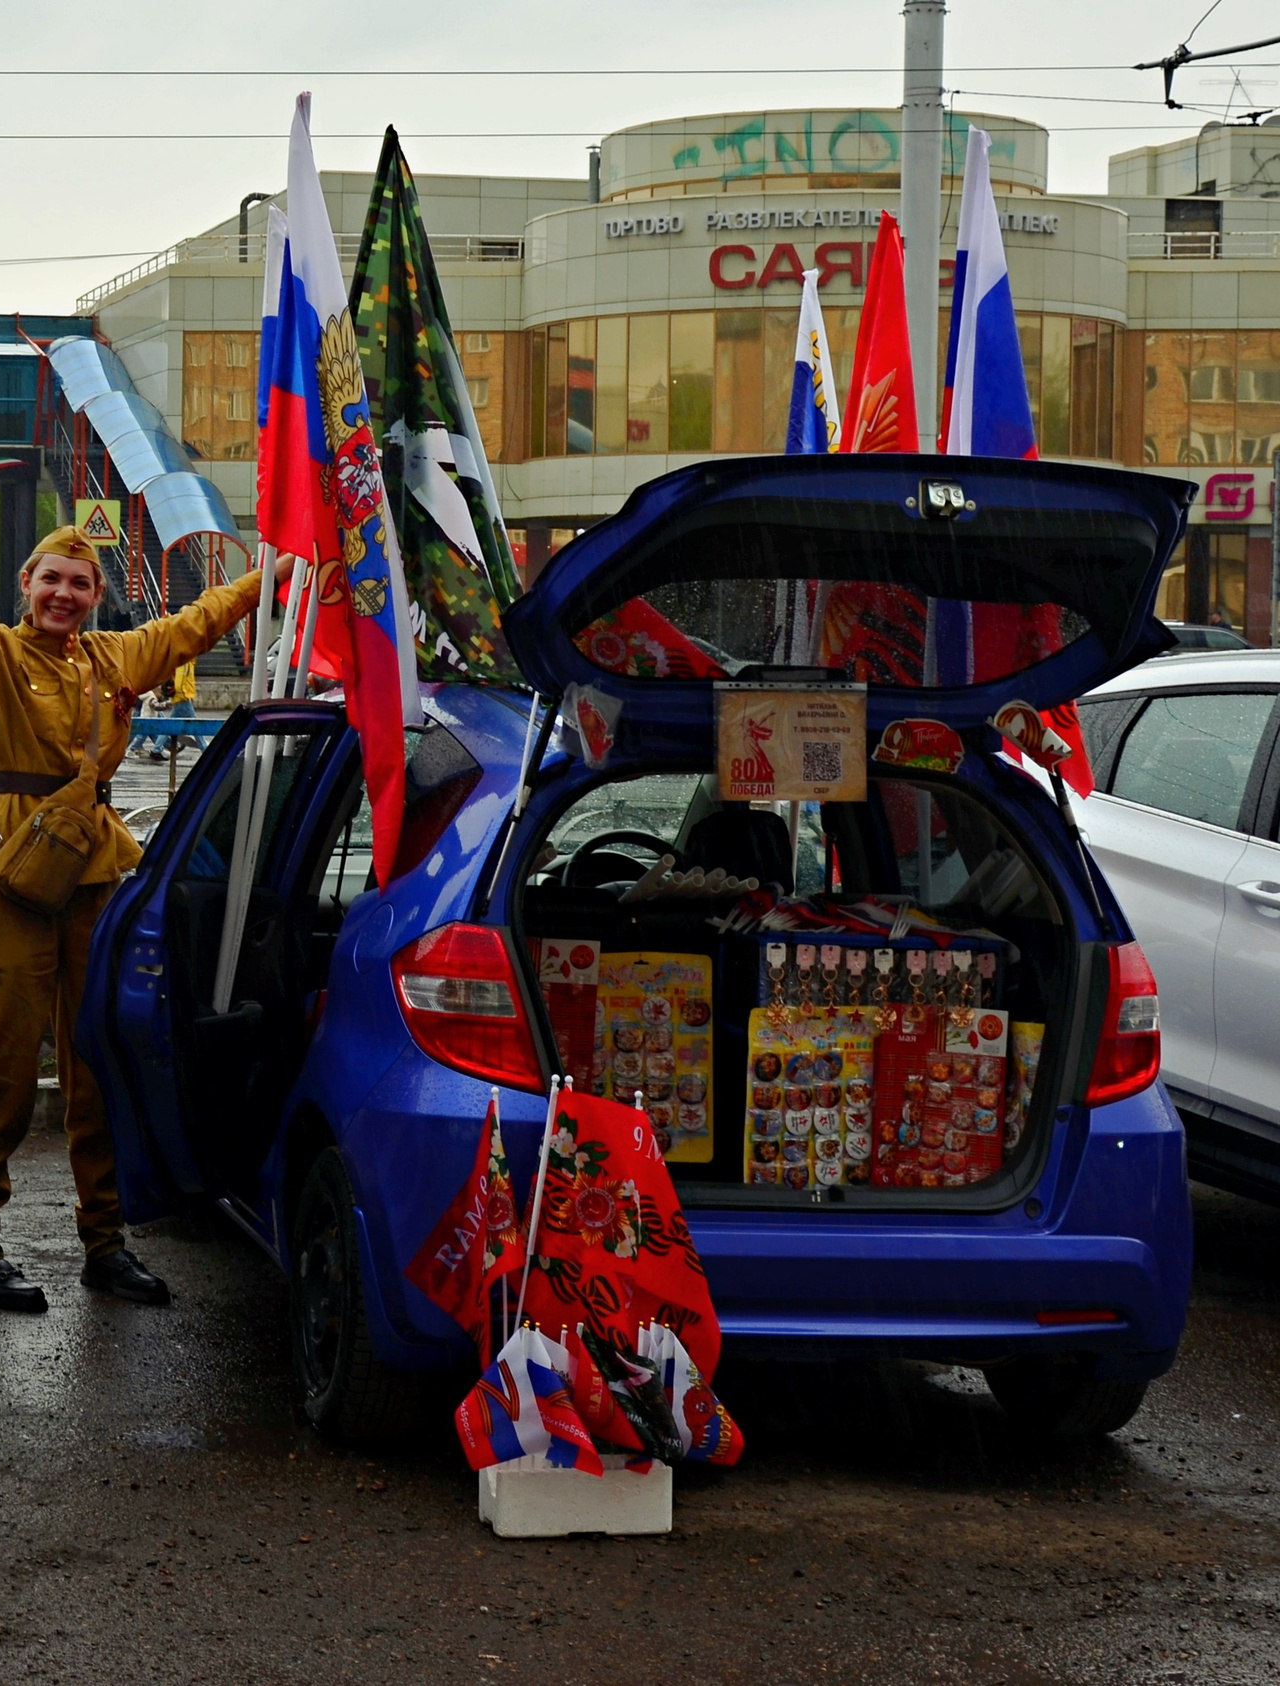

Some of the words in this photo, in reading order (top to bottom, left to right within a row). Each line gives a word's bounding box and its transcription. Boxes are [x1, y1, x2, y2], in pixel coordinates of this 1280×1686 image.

[604, 211, 685, 239] ТОРГОВО
[706, 207, 900, 232] РАЗВЛЕКАТЕЛЬ
[708, 241, 957, 290] САЯ
[731, 757, 755, 780] 80
[729, 784, 775, 797] ПОБЕДА!
[897, 1034, 917, 1043] мая
[633, 1126, 644, 1151] 9
